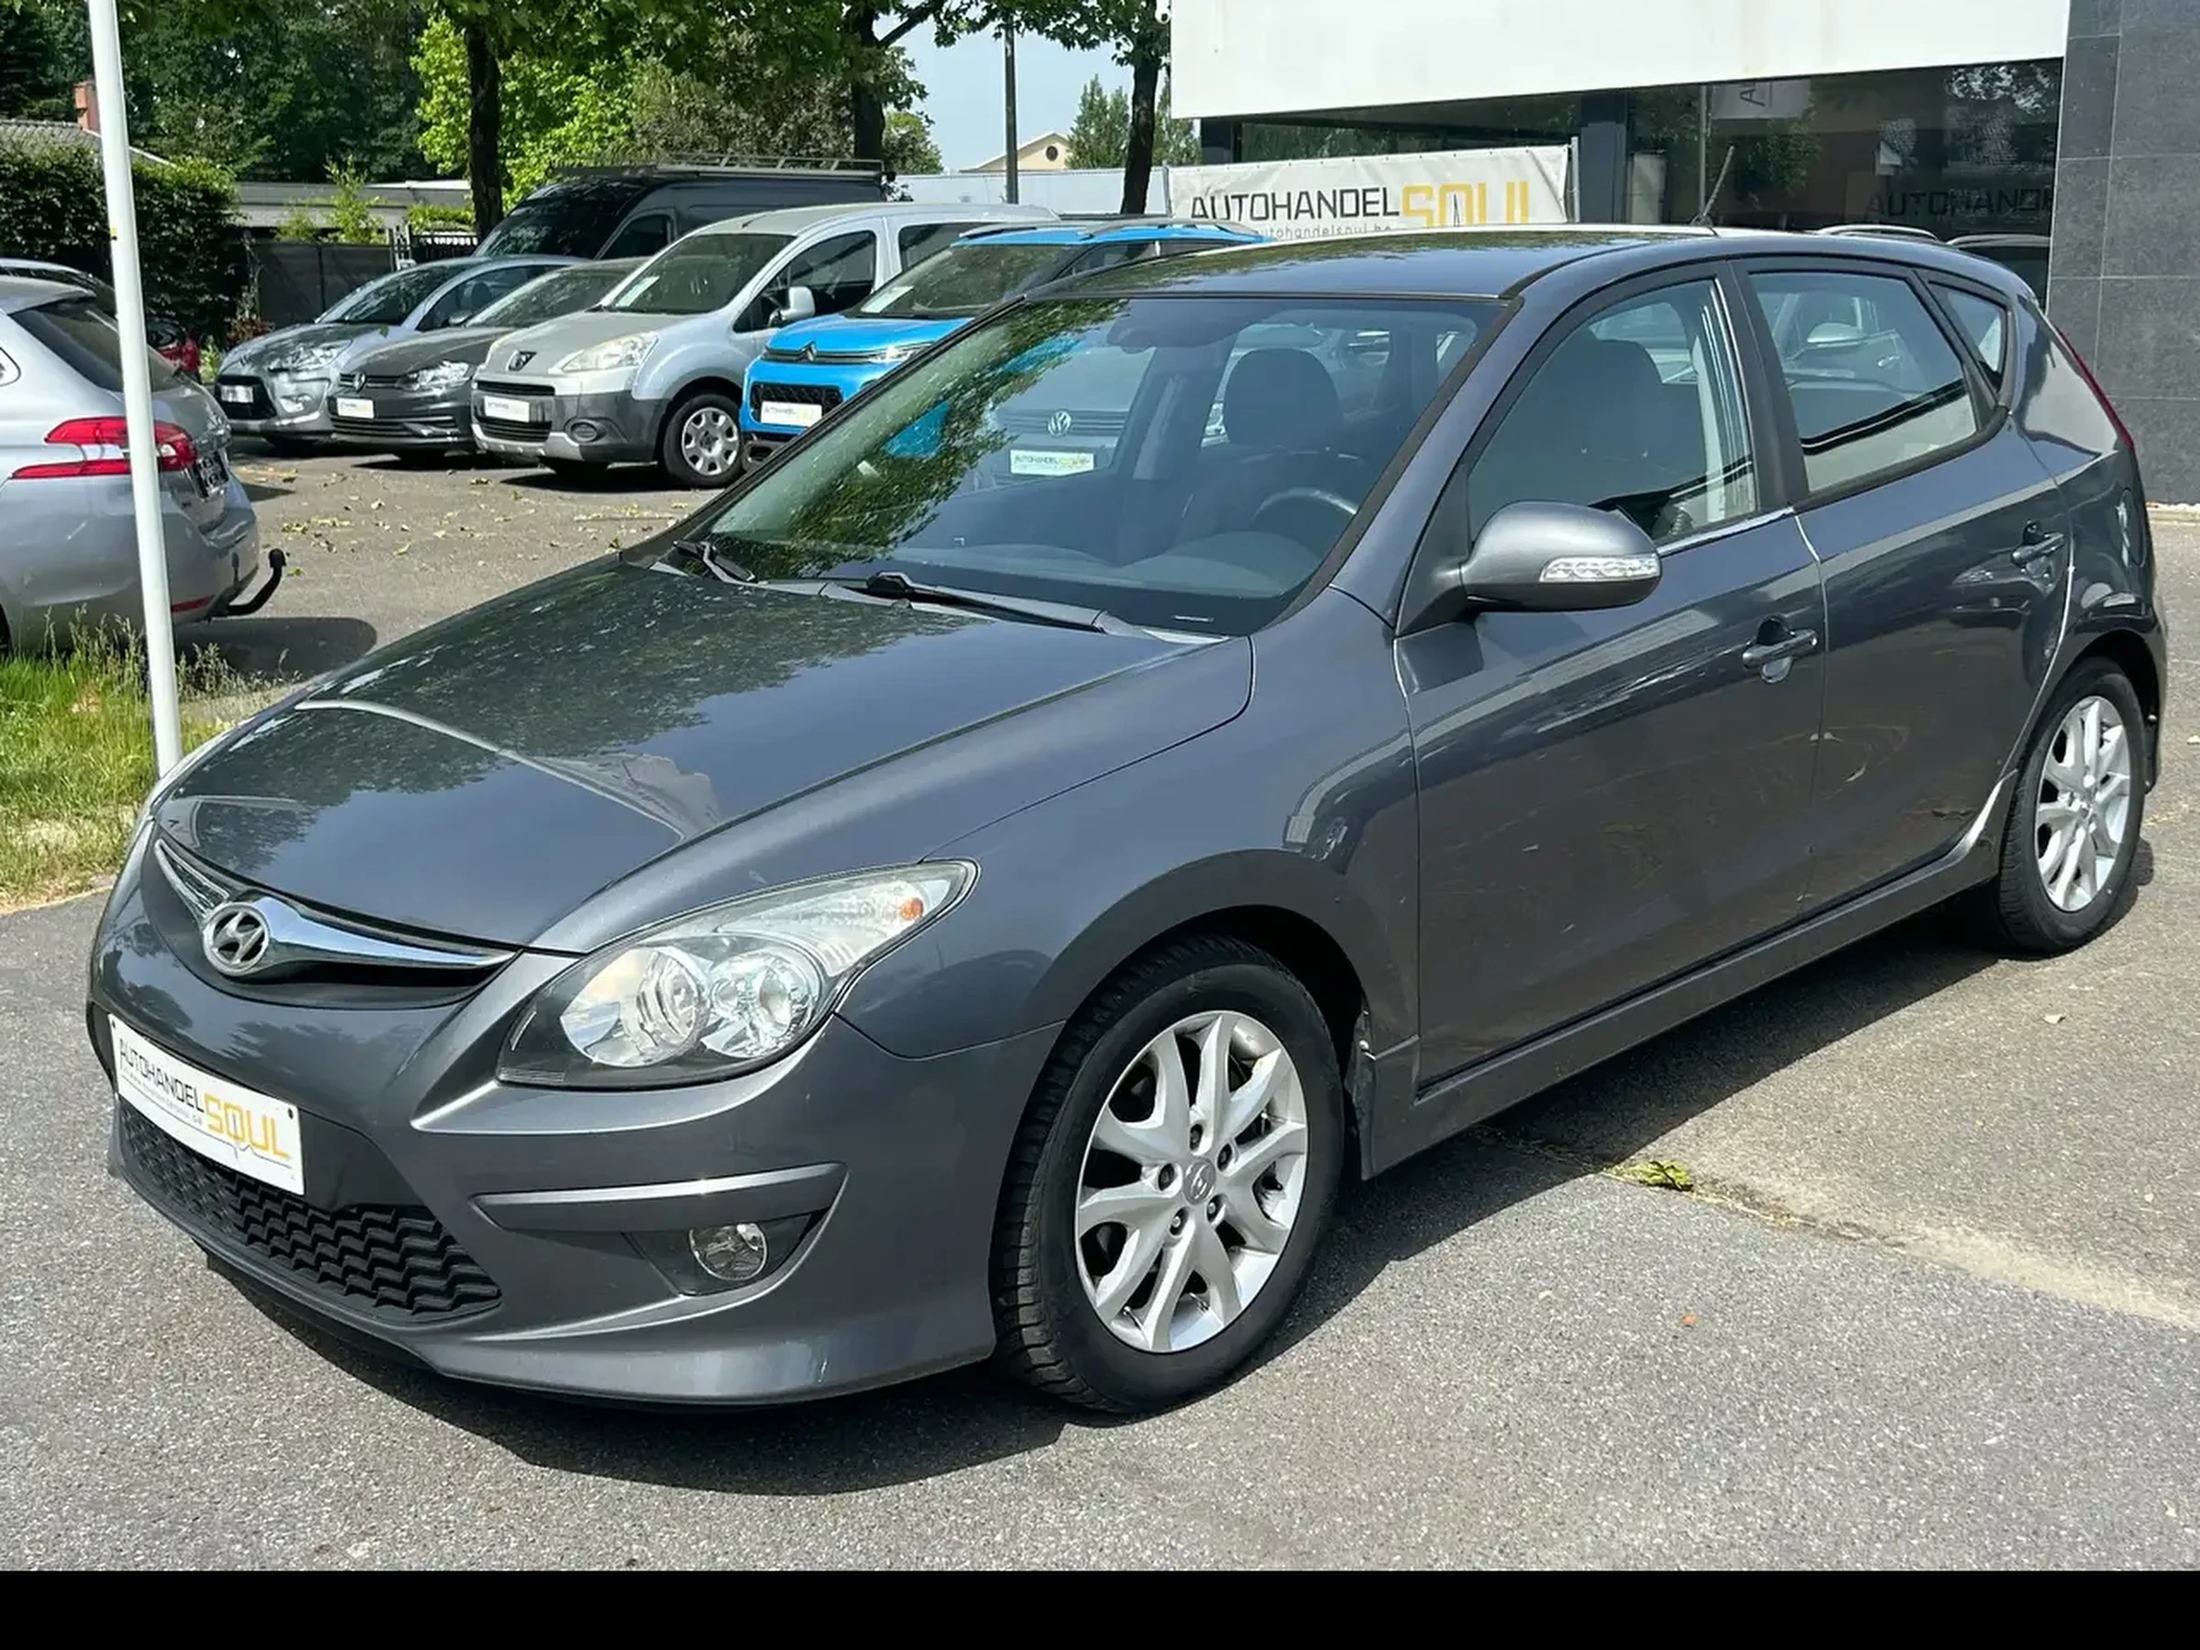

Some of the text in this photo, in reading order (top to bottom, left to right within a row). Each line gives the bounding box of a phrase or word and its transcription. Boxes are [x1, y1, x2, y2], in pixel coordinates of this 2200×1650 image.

[1190, 187, 1400, 221] AUTOHANDEL
[120, 1039, 204, 1112] AUTOHANDEL
[206, 1095, 289, 1159] SOUL
